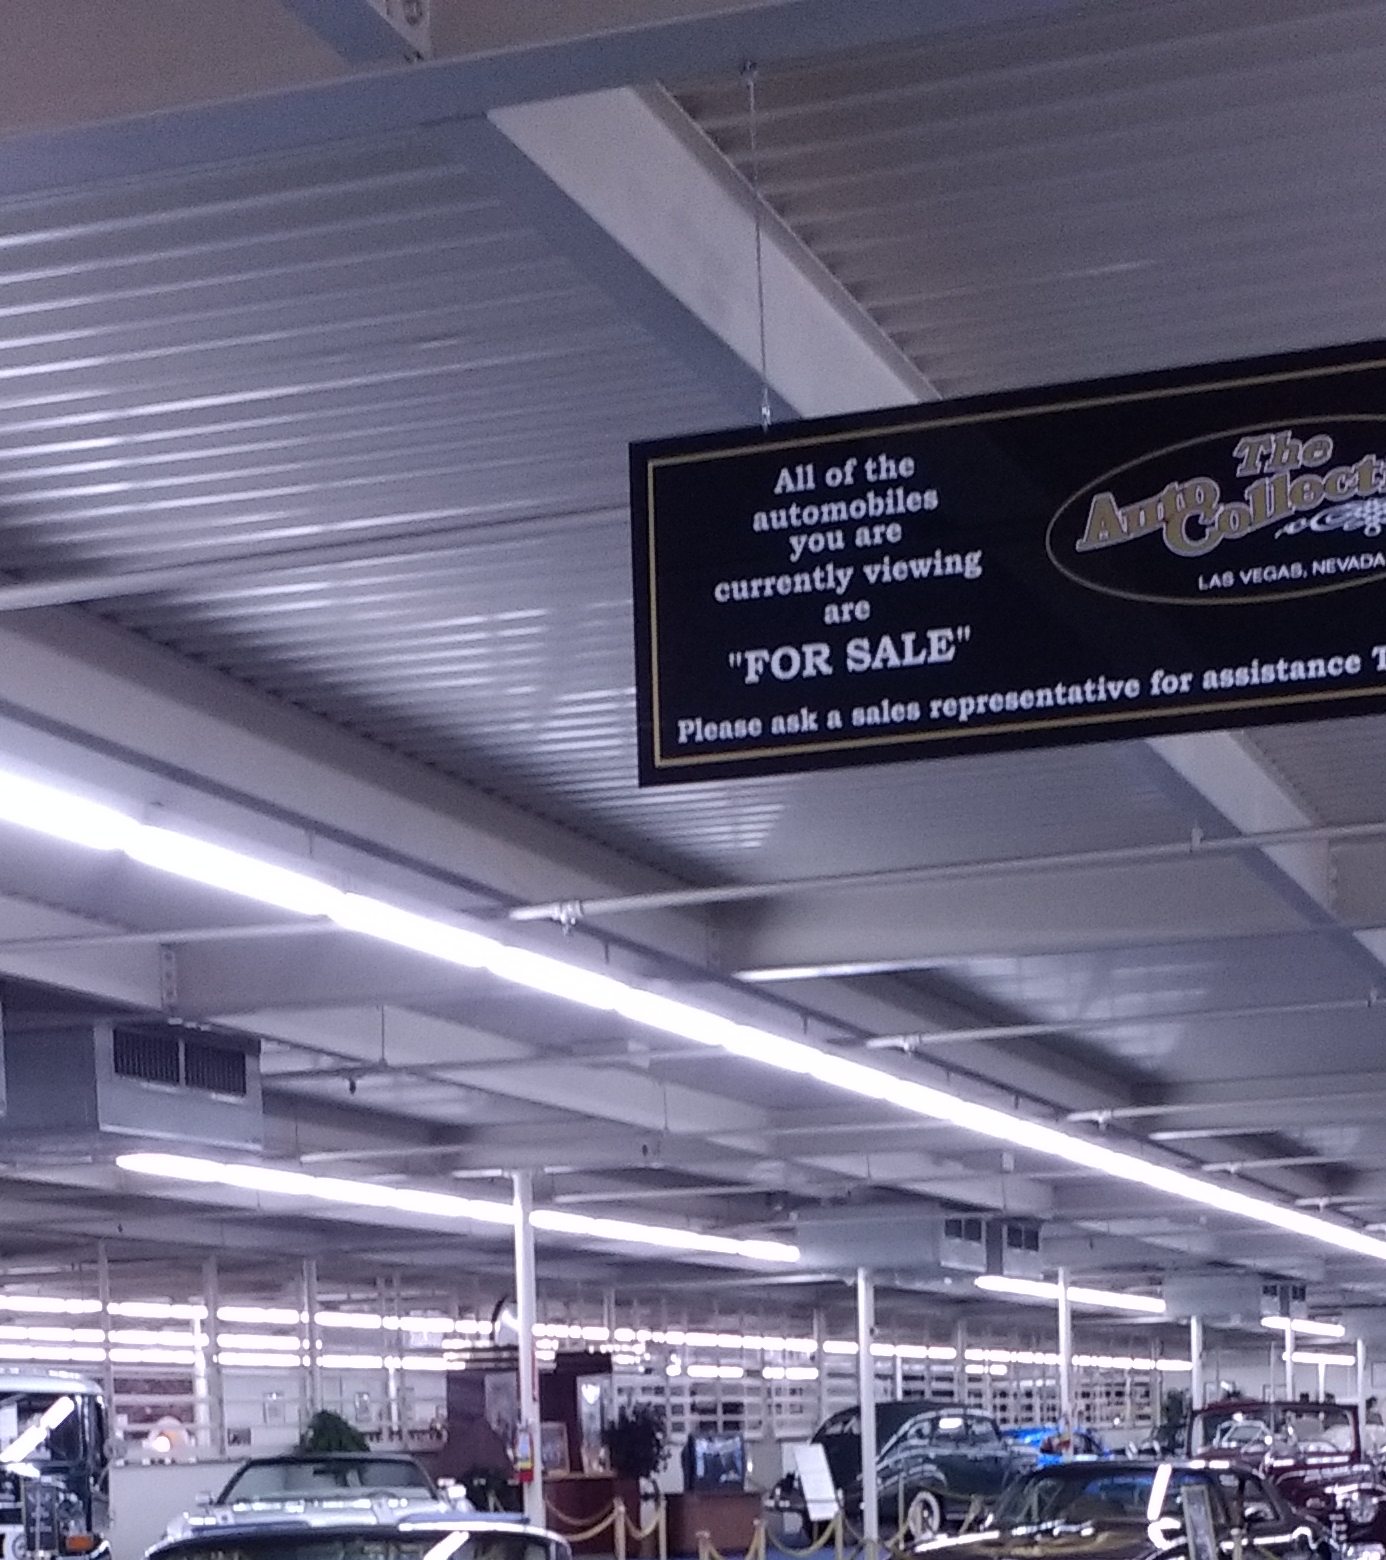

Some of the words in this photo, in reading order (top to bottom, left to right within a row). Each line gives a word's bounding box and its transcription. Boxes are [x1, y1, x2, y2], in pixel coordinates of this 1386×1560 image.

[773, 463, 815, 494] All
[825, 457, 857, 487] of
[865, 453, 915, 482] the
[1234, 430, 1333, 478] The
[753, 486, 938, 532] automobiles
[1075, 477, 1220, 552] Auto
[789, 529, 844, 562] you
[855, 522, 902, 547] are
[714, 562, 853, 602] currently
[864, 549, 983, 584] viewing
[1198, 569, 1234, 591] LAS
[1239, 564, 1308, 587] VEGAS,
[1313, 552, 1386, 576] NEVADA
[824, 600, 870, 625] are
[728, 642, 833, 684] "FOR
[846, 625, 971, 673] SALE"
[678, 716, 762, 744] Please
[771, 707, 818, 735] ask
[826, 708, 843, 730] a
[852, 699, 920, 727] sales
[930, 675, 1140, 722] representative
[1150, 669, 1193, 696] for
[1202, 654, 1362, 691] assistance
